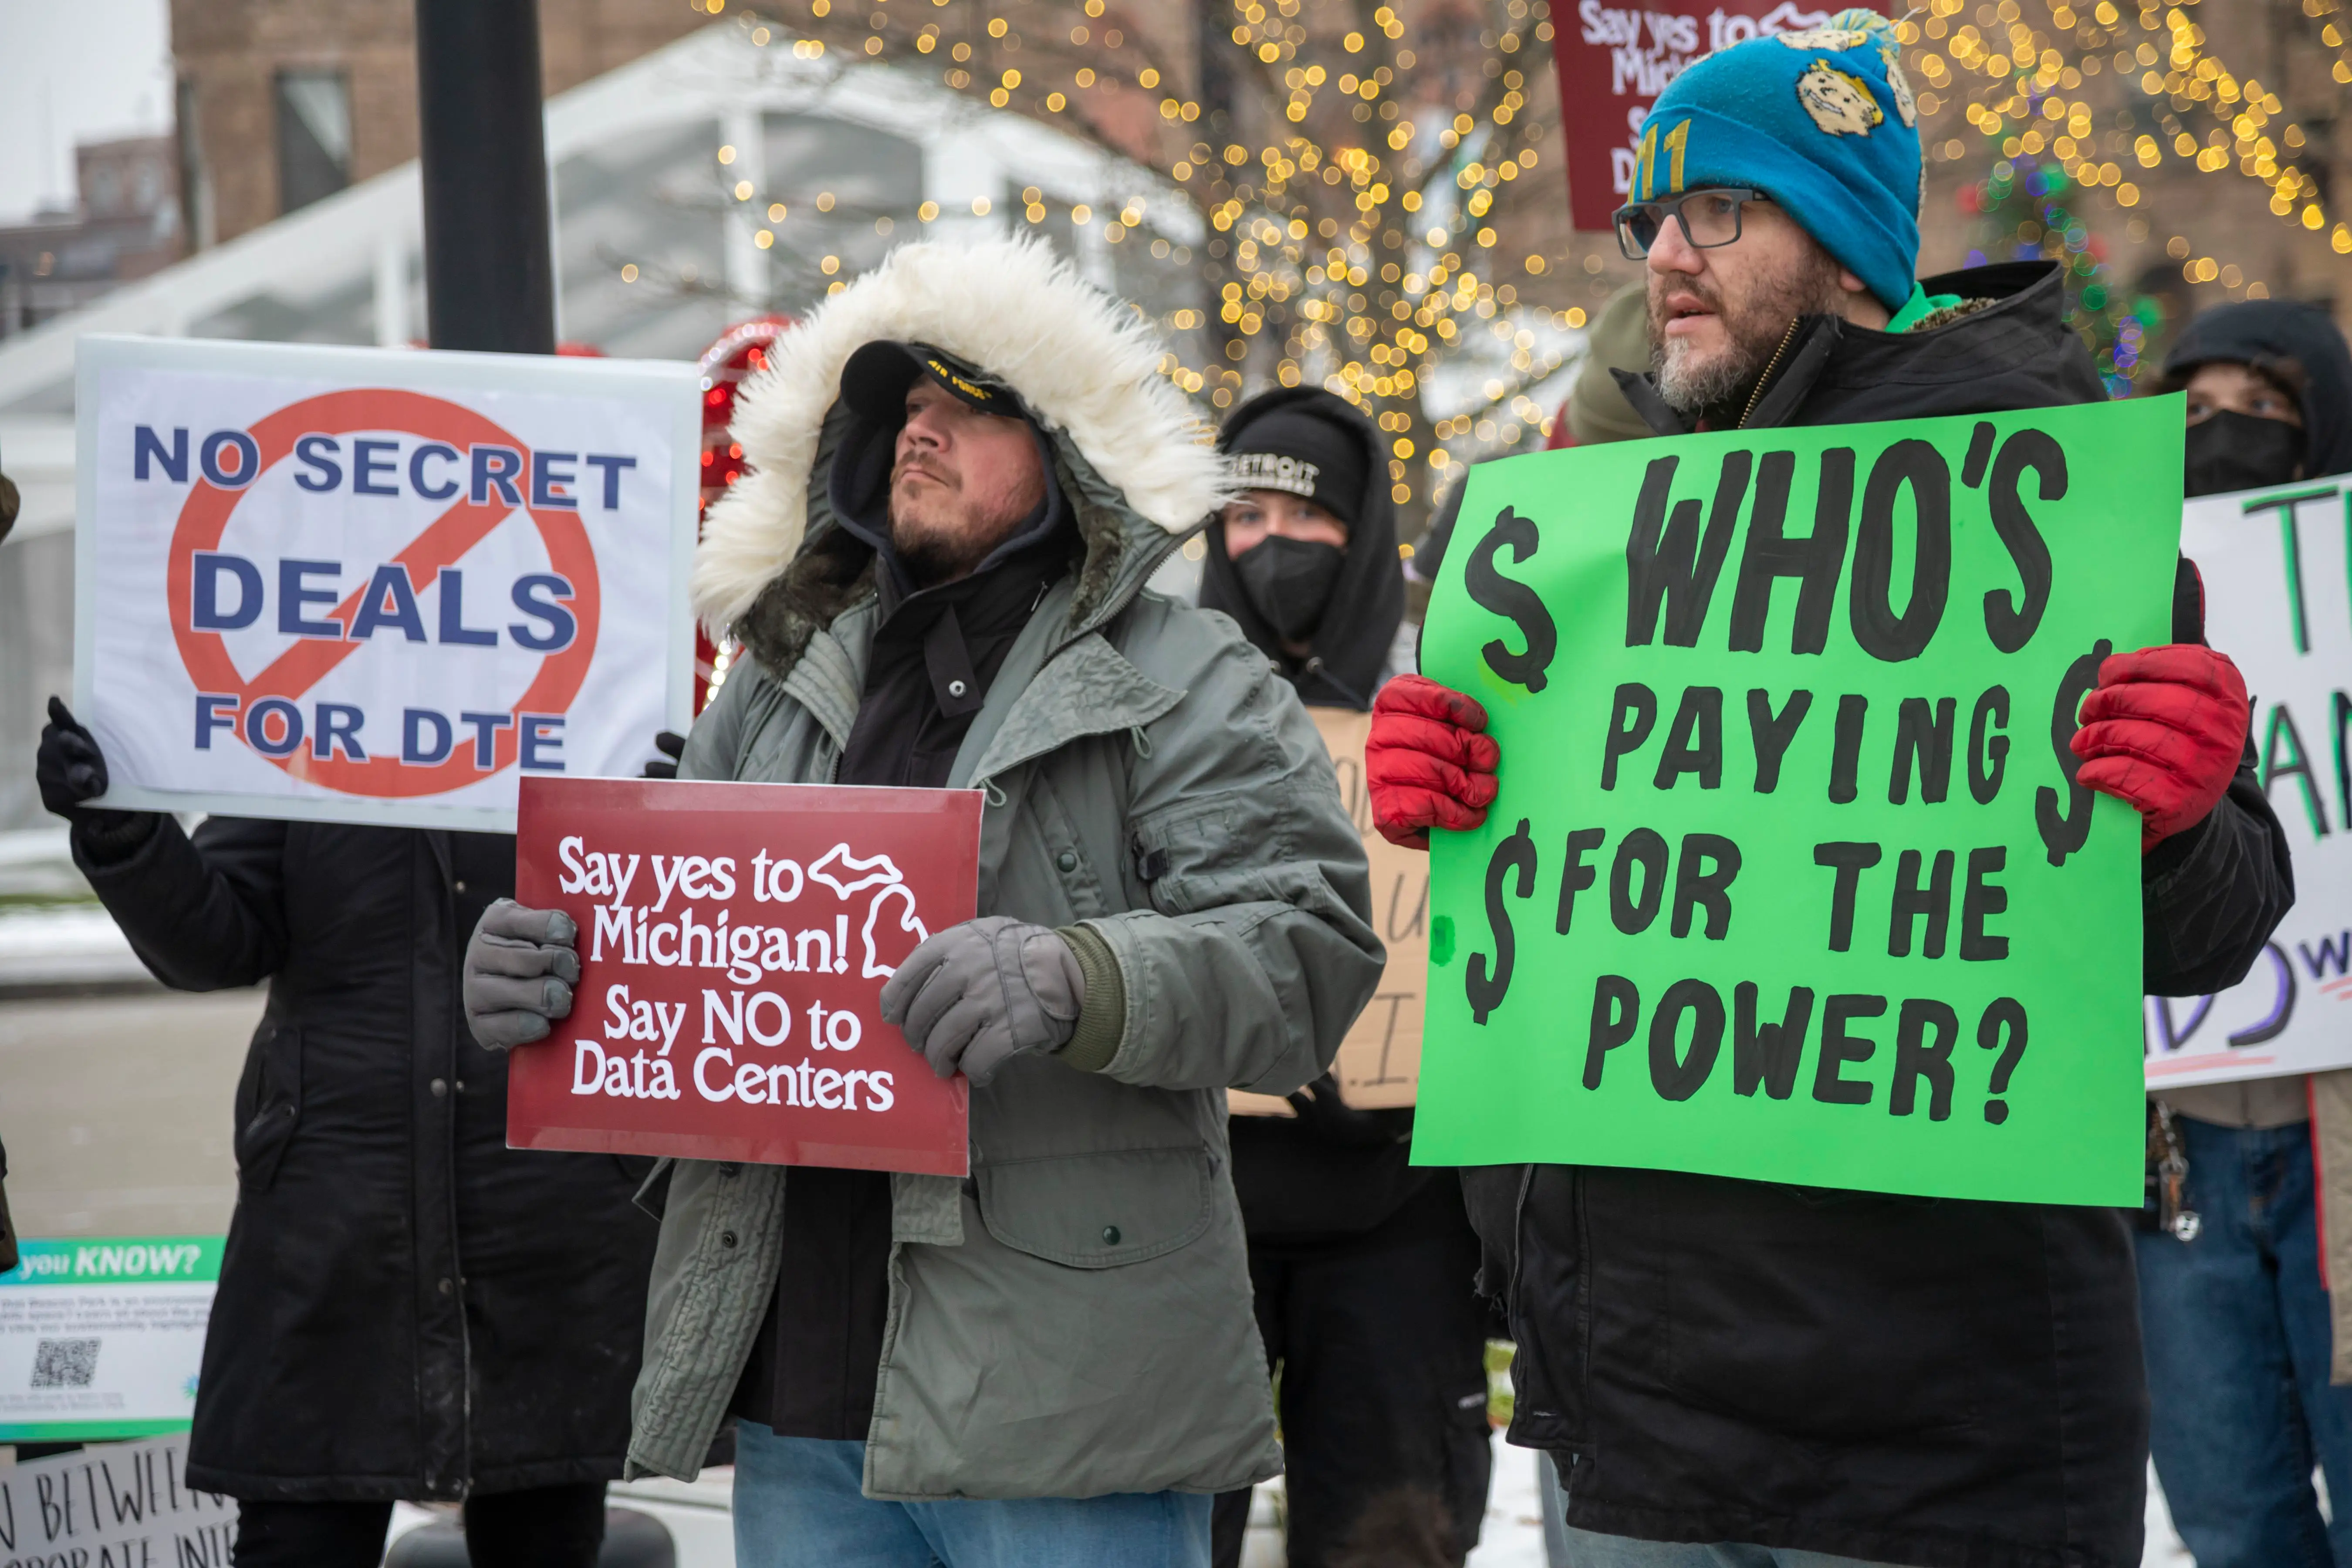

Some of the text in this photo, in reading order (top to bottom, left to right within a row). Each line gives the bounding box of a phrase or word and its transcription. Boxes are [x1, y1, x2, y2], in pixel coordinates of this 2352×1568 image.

[1578, 0, 1757, 57] Say yes to
[928, 360, 948, 378] AIR
[134, 426, 636, 510] NO SECRET
[1625, 421, 2068, 662] WHO'S
[192, 554, 575, 651] DEALS
[194, 696, 566, 771] FOR DTE
[1601, 683, 2010, 805] PAYING
[559, 836, 804, 913] Say yes to
[1555, 827, 1741, 940] FOR
[1813, 841, 2008, 961] THE
[590, 905, 849, 985] Michigan!
[604, 984, 862, 1056] Say NO to
[1582, 974, 2028, 1125] POWER?
[571, 1040, 894, 1112] Data Centers
[19, 1244, 202, 1281] you KNOW?
